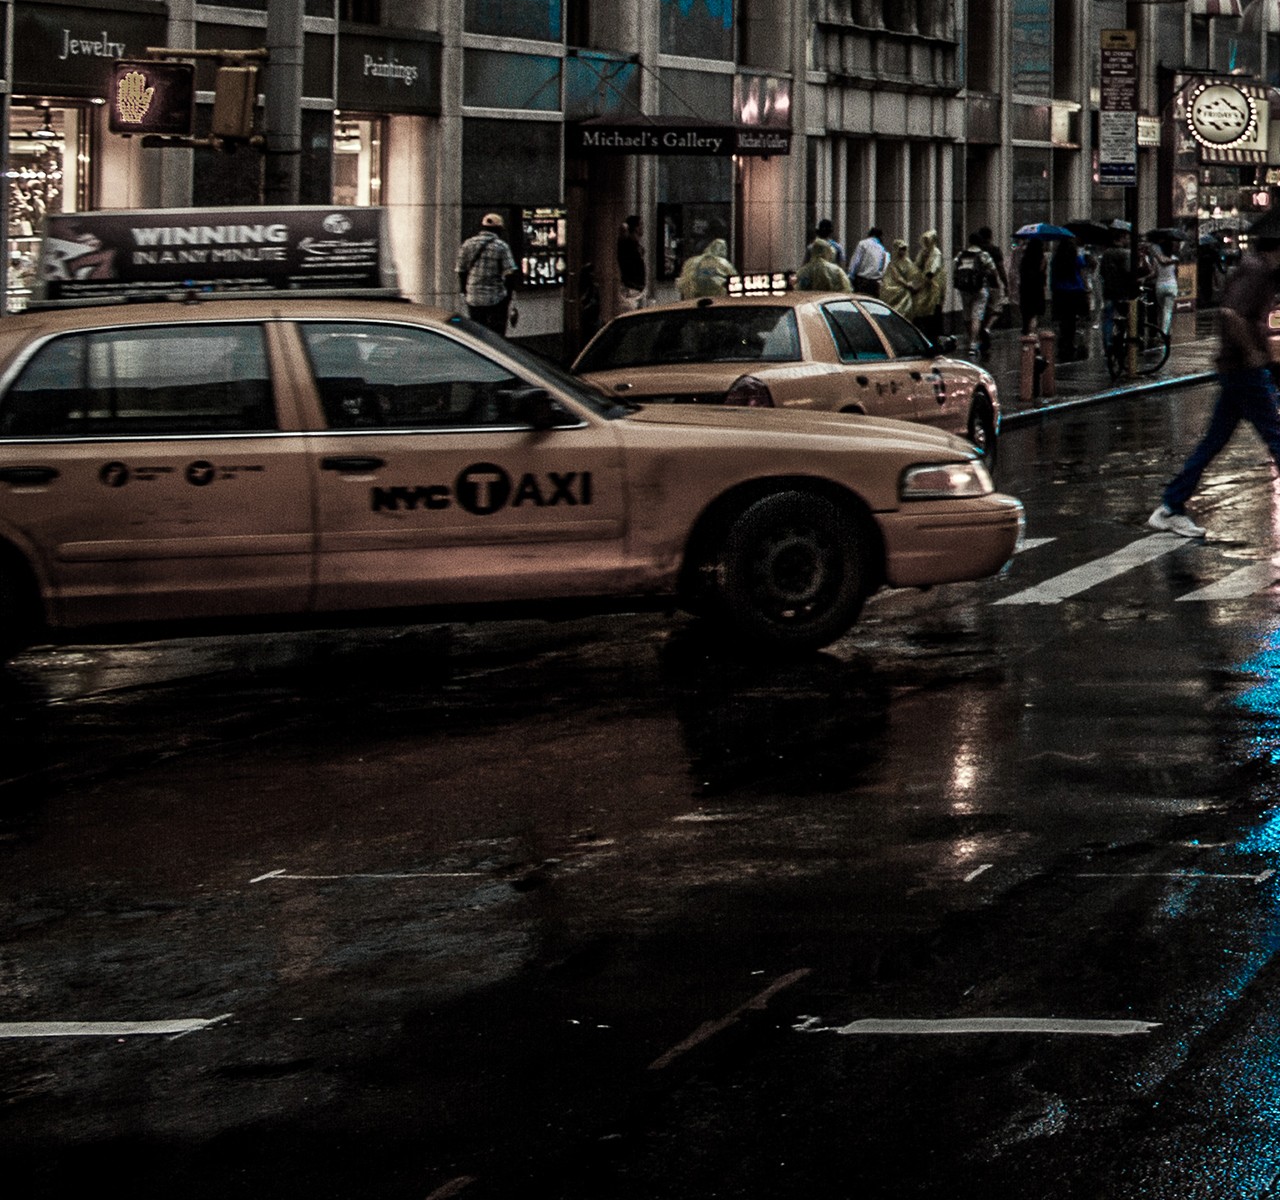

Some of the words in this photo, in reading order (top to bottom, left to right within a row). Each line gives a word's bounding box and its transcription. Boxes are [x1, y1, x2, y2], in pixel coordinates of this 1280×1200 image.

[60, 29, 126, 60] Jewelry
[363, 54, 419, 86] Paintings
[582, 131, 657, 148] Michael's
[662, 131, 723, 153] Gallery
[131, 224, 288, 247] WINNING
[371, 485, 449, 513] NYC
[456, 463, 592, 515] TAXI
